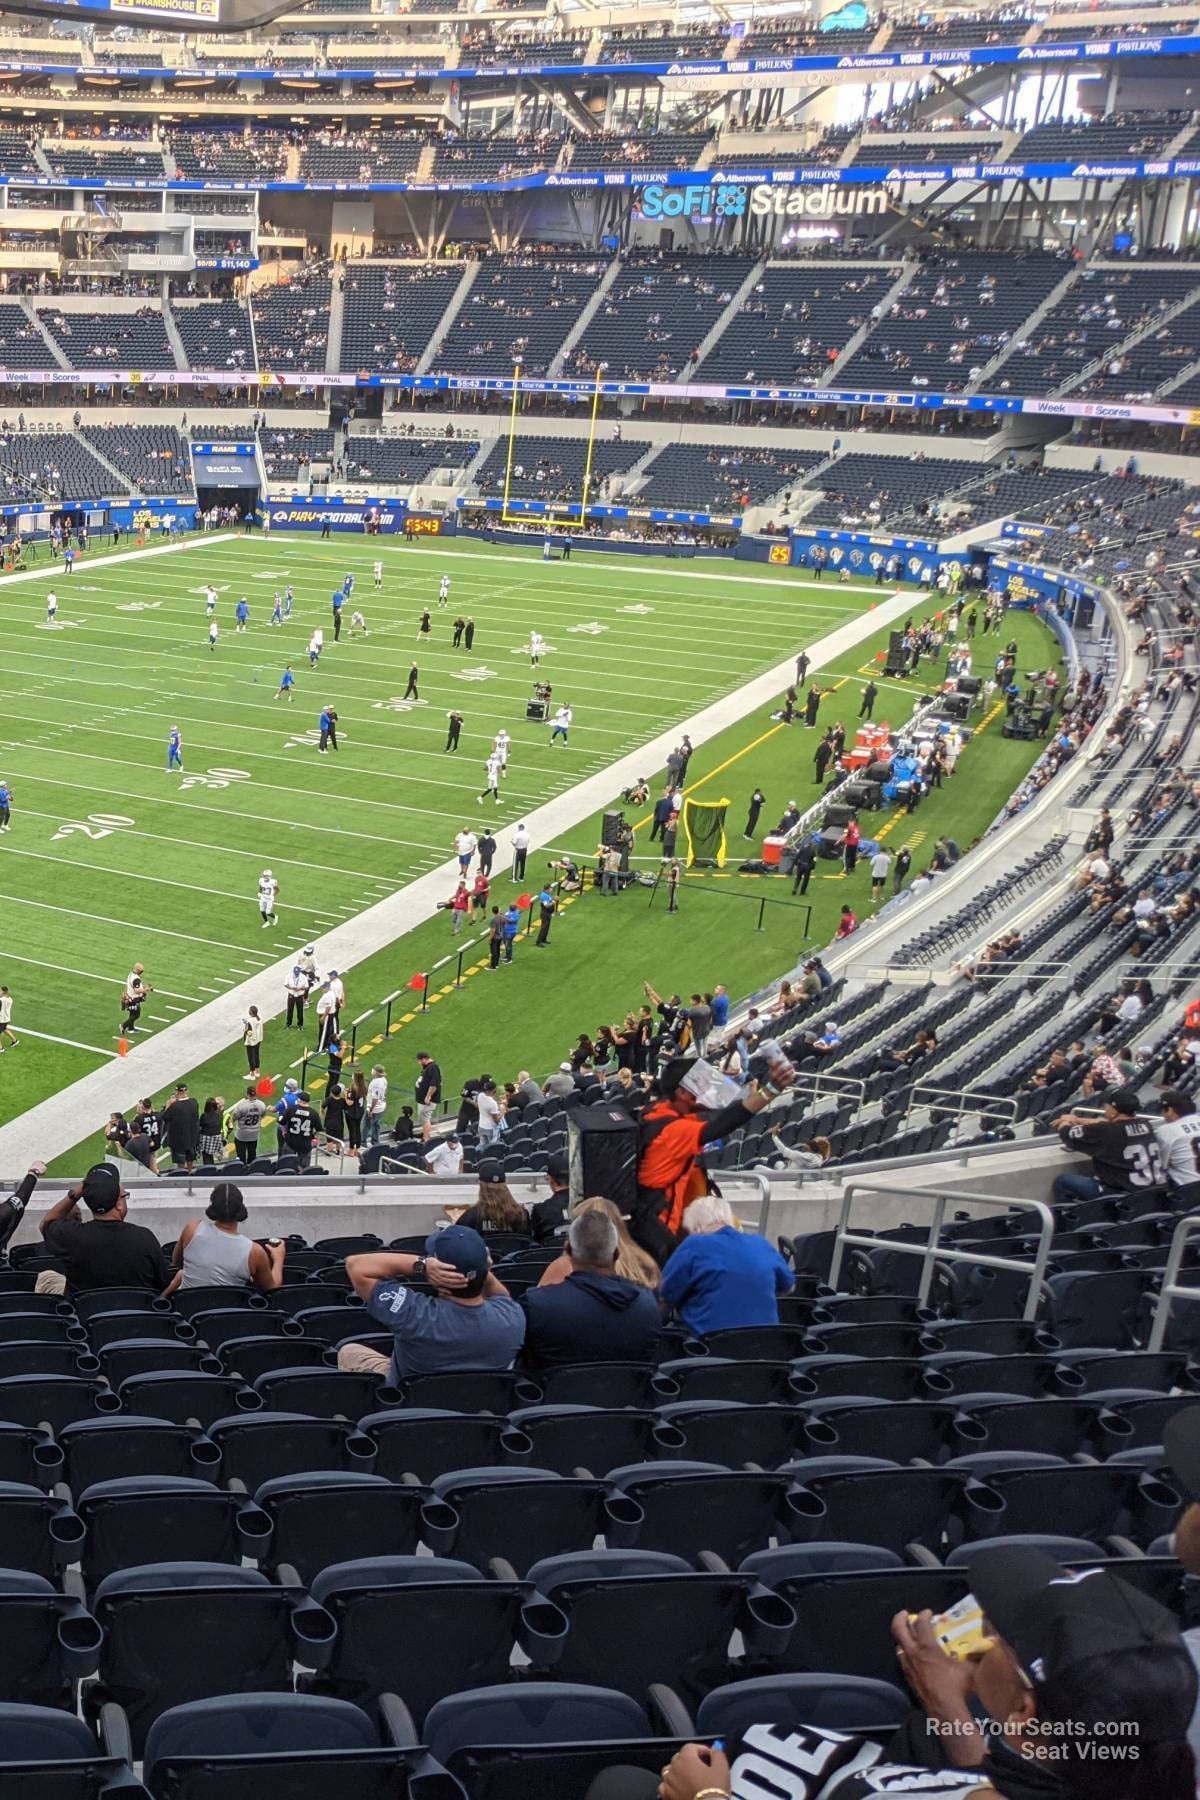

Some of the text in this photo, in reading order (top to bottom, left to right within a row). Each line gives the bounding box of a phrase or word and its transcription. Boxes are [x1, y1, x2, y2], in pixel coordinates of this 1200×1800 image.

[1034, 40, 1162, 58] Albertsons VONS PAVILIONS
[852, 51, 970, 66] Albertsons VONS PAVILIONS
[682, 59, 792, 74] Albertsons VONS PAVILIONS
[901, 165, 1024, 180] Albertsons VONS PAVILIONS
[1088, 162, 1168, 176] Albertsons VONS
[560, 173, 668, 185] Albertsons VONS PAVILIONS
[726, 170, 840, 184] Albertsons VONS PAVILIONS
[642, 184, 888, 216] SoFi Stadium
[221, 259, 250, 269] $11,140
[6, 373, 28, 382] Week
[52, 373, 80, 382] Scores
[192, 374, 210, 382] FINAL
[1037, 402, 1066, 413] Week
[1096, 406, 1131, 417] Scores
[212, 446, 237, 454] RAMS
[771, 546, 788, 562] 25
[182, 767, 252, 789] 30
[57, 813, 136, 840] 20
[290, 1117, 311, 1137] 34
